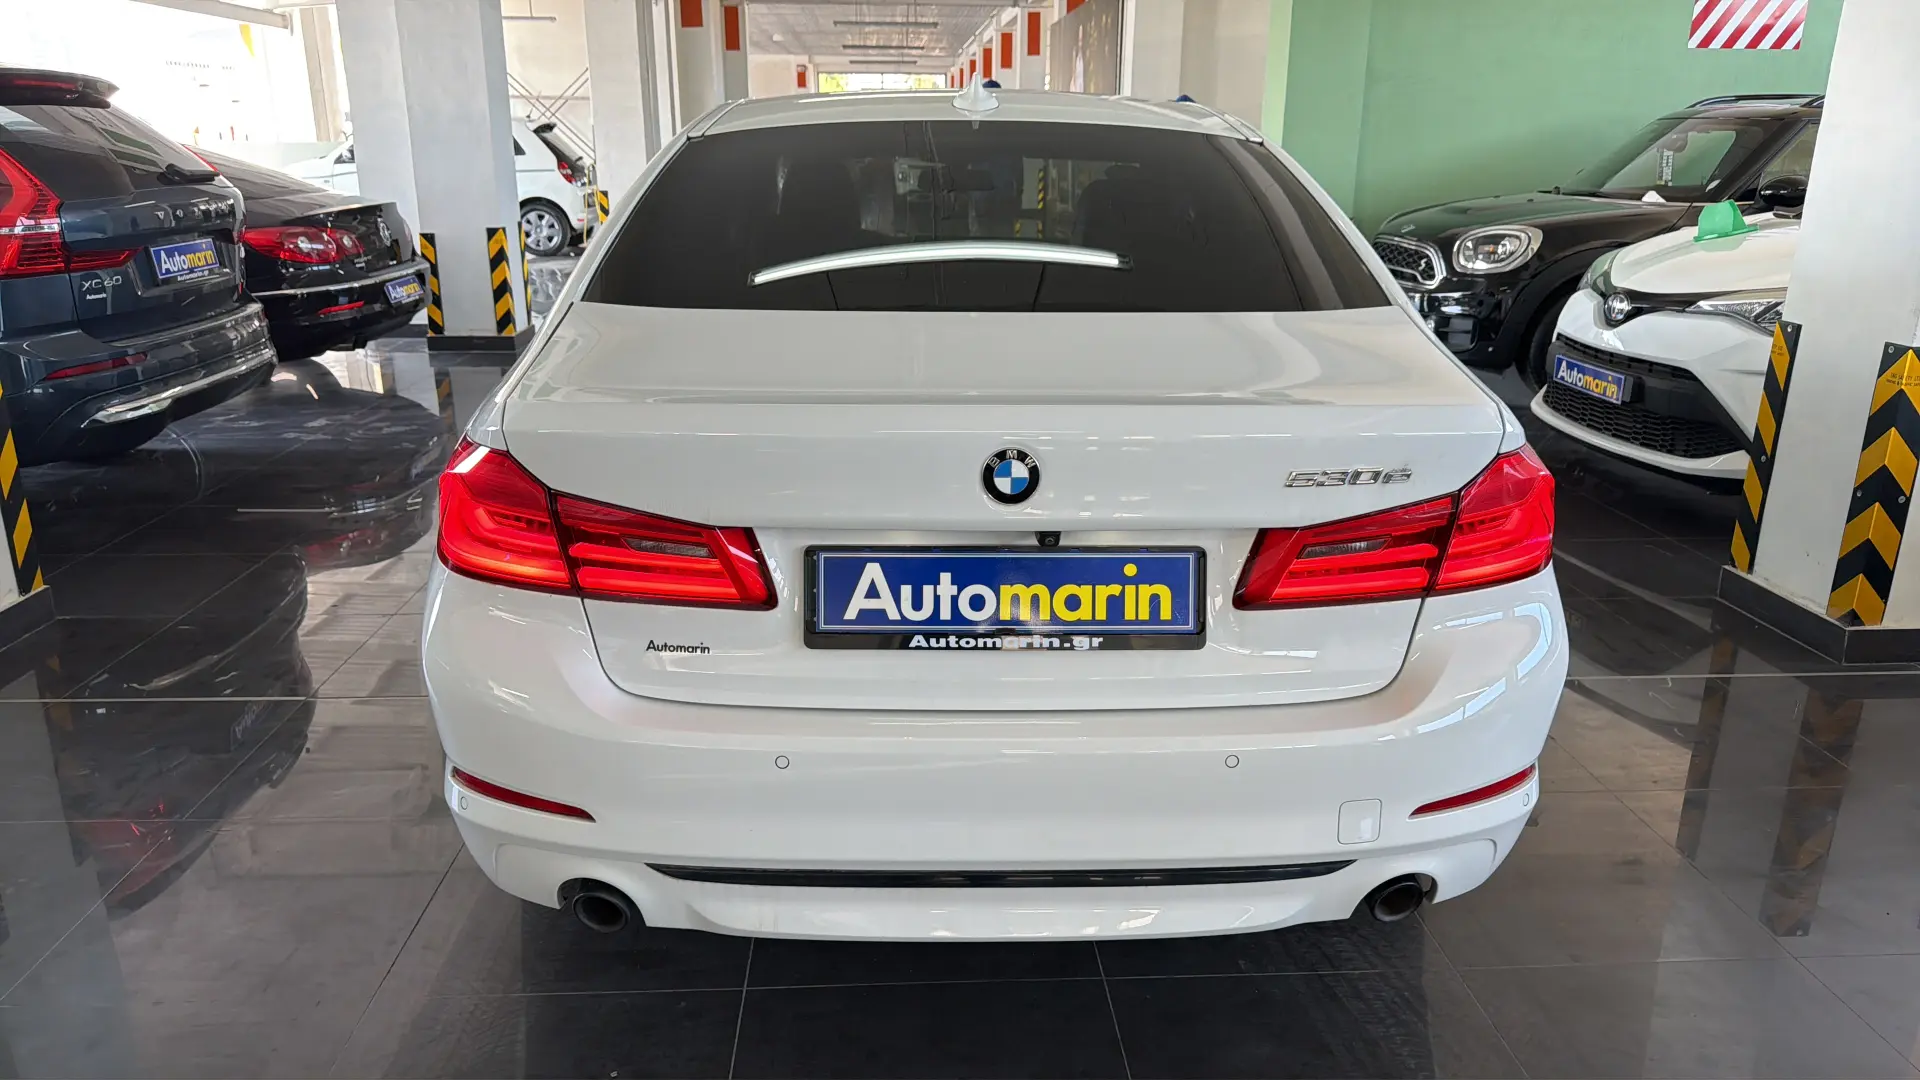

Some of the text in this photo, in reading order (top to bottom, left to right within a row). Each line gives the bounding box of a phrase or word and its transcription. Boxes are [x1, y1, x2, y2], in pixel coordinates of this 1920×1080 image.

[160, 243, 215, 273] Automarin
[81, 275, 123, 291] XC60
[1558, 360, 1619, 400] Automarin
[988, 449, 1037, 469] BMW
[1285, 467, 1412, 487] 530e
[843, 562, 1172, 621] Automarin
[646, 640, 711, 654] Automarin
[909, 634, 1103, 651] Automarin.gr
